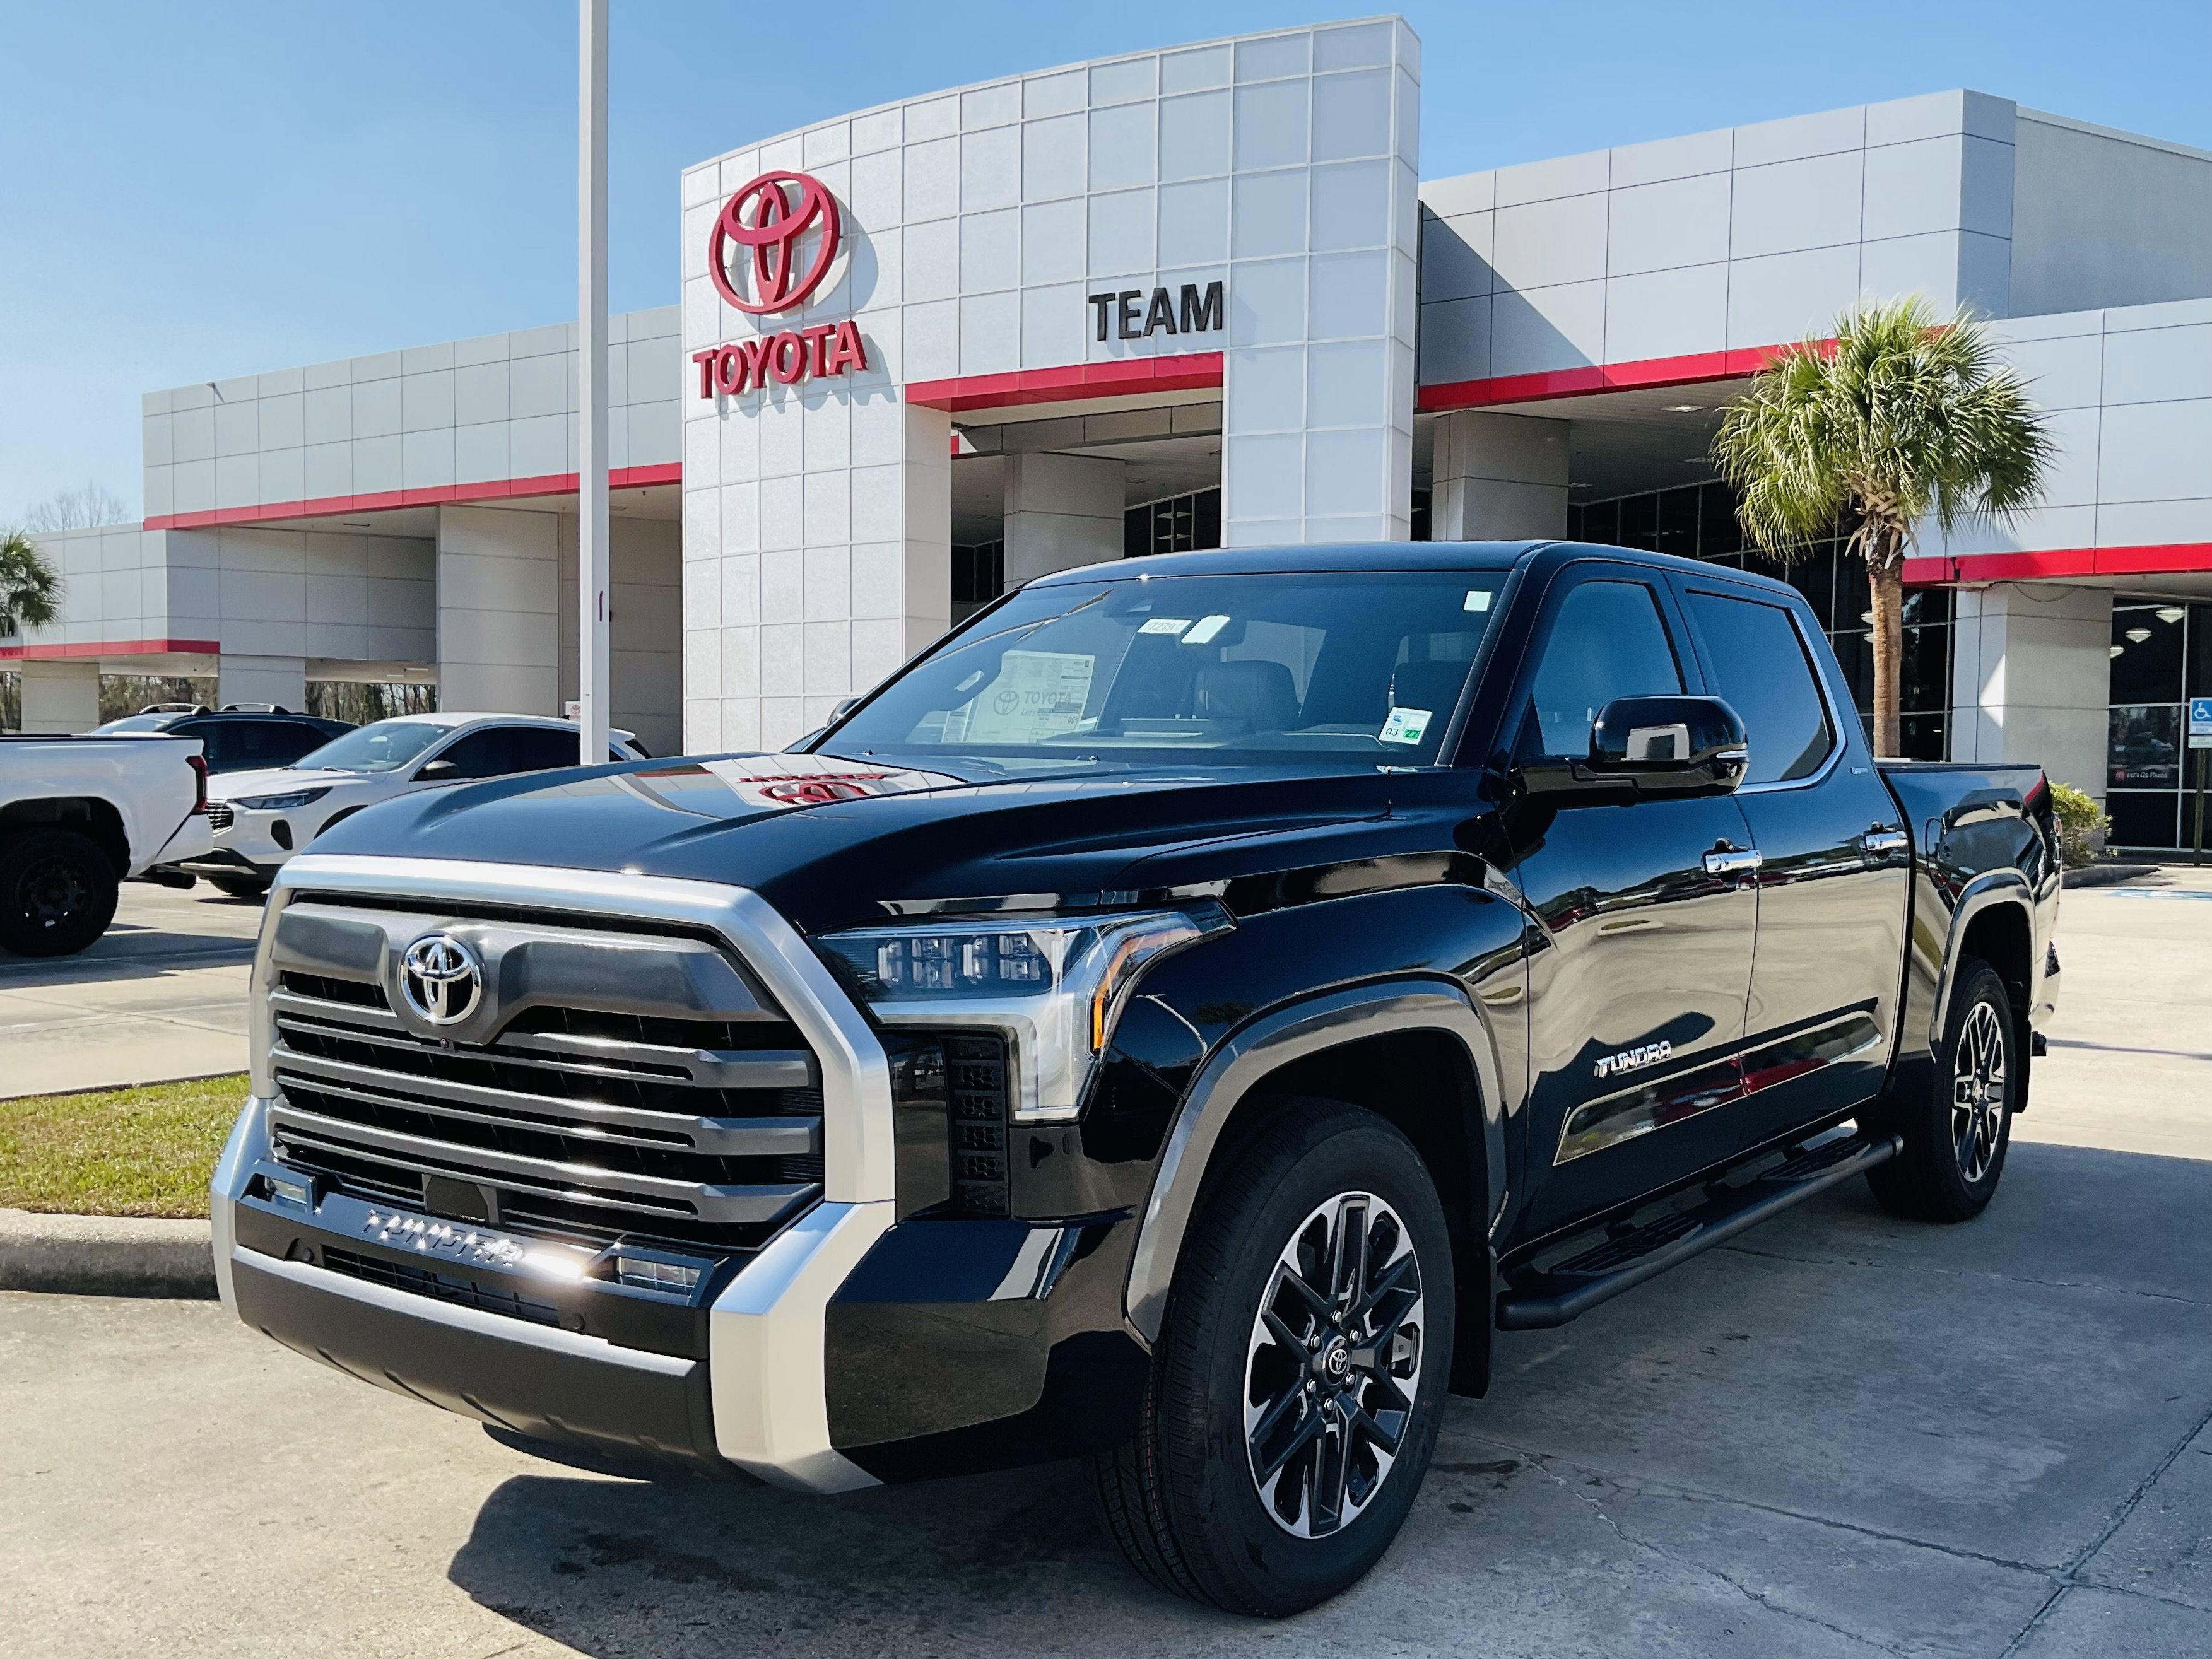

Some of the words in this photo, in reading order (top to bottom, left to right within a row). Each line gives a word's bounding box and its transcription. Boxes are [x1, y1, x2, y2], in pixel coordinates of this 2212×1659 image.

[1088, 281, 1223, 341] TEAM
[693, 320, 868, 399] TOYOTA
[1024, 691, 1071, 705] TOYOTA
[1385, 727, 1399, 736] 03
[1404, 729, 1421, 738] 27
[1594, 1040, 1671, 1078] TUNDRA
